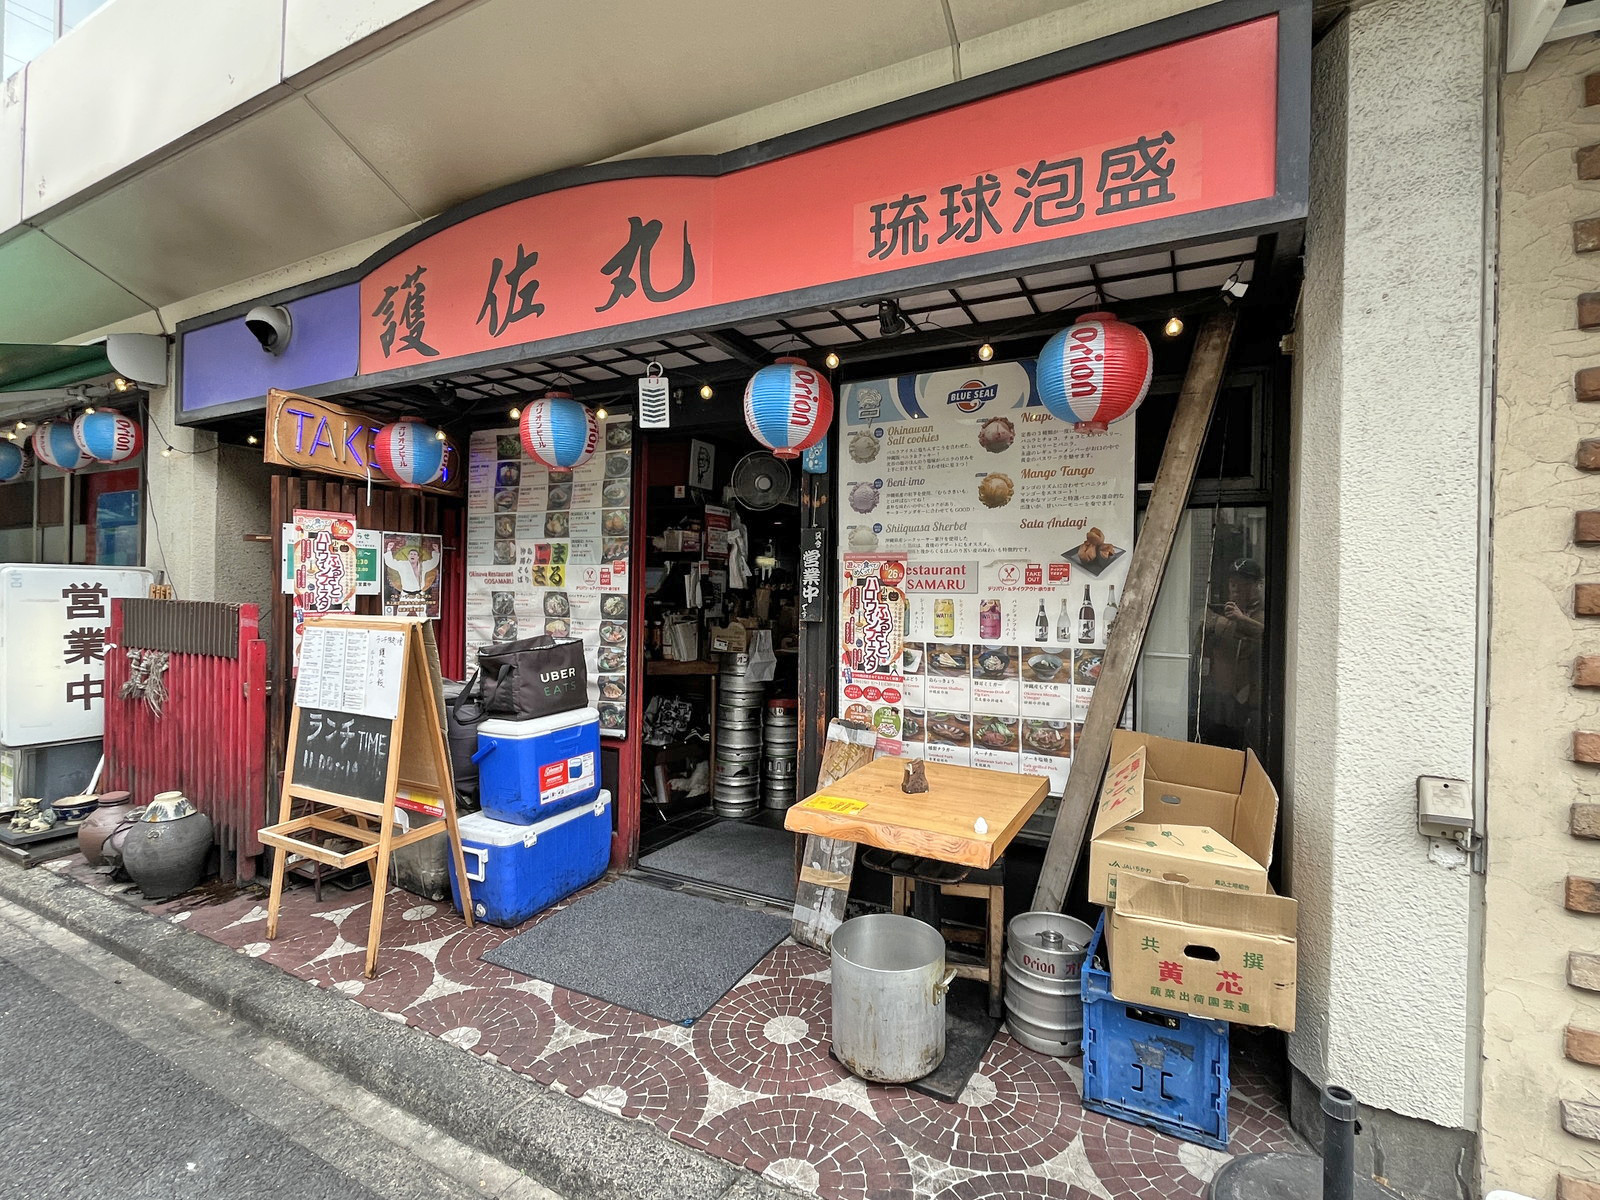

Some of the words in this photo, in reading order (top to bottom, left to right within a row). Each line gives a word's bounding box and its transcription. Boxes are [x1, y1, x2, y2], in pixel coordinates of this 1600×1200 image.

[868, 130, 1178, 260] 琉球泡盛
[372, 216, 695, 361] 護佐丸
[1070, 327, 1103, 397] Orion
[791, 371, 818, 426] Orion
[951, 391, 972, 401] BLUE
[973, 388, 995, 399] SEAL
[116, 419, 135, 451] Orion
[535, 402, 546, 448] オリオンビール
[886, 436, 905, 446] Salt
[907, 433, 940, 445] cookies
[887, 425, 934, 436] Okinawan
[398, 426, 408, 467] オリオンビール
[886, 477, 926, 487] Beni-imo
[1020, 468, 1057, 480] Mango
[1060, 465, 1095, 478] Tango
[932, 521, 968, 532] Sherbet
[1019, 518, 1044, 530] Sata
[1047, 516, 1088, 530] Andagi
[802, 549, 821, 604] 営業中
[906, 564, 966, 576] estaurant
[907, 579, 966, 590] SAMARU
[863, 578, 880, 672] ハロウィンフェスタ
[876, 606, 891, 656] ふるさと
[62, 582, 109, 711] 営業中
[540, 667, 576, 683] UBER
[544, 681, 576, 697] EATS
[307, 713, 356, 748] ランチ
[358, 731, 387, 755] TIME
[1121, 864, 1152, 874] JAいちかわ
[1023, 954, 1056, 975] Orion
[1141, 936, 1160, 954] 共
[1242, 951, 1264, 971] 撰
[1158, 960, 1244, 995] 黄芯
